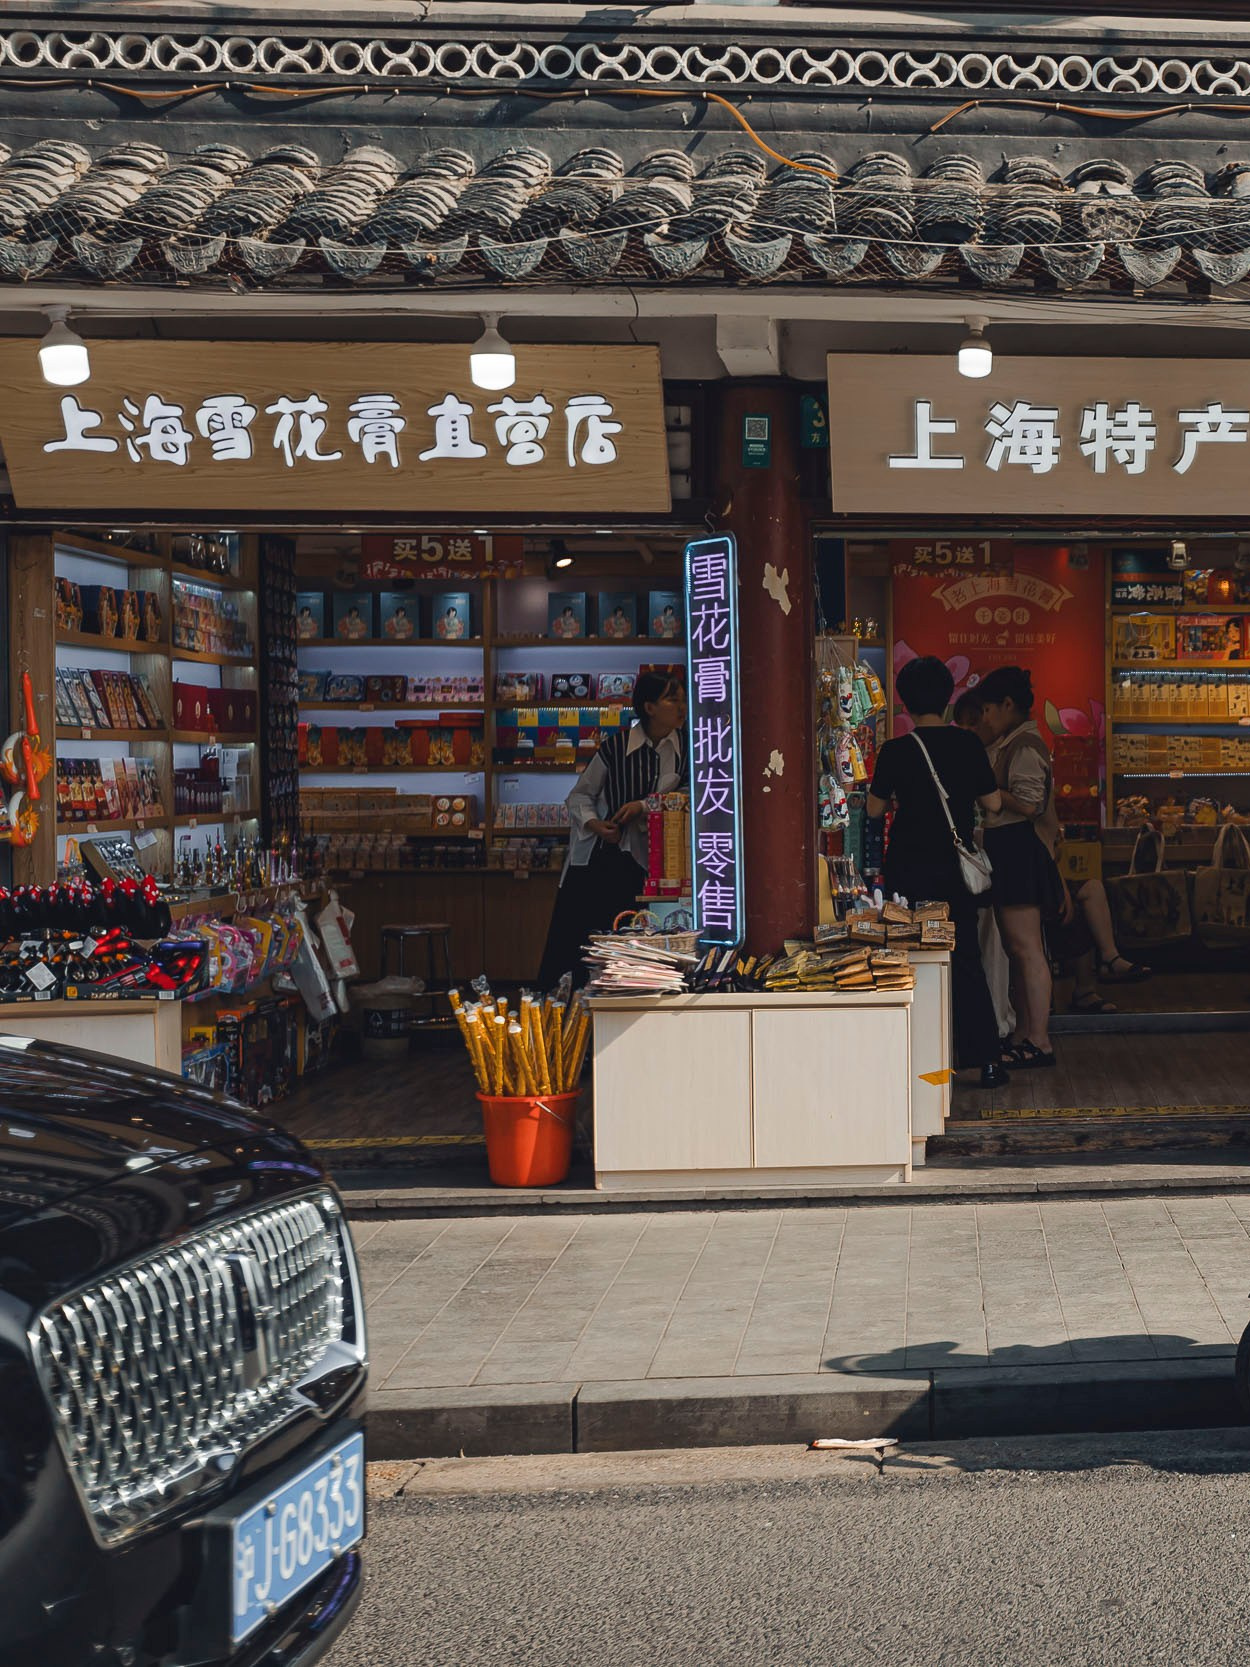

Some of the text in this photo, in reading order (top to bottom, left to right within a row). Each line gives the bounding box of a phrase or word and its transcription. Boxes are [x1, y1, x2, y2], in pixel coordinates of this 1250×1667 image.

[42, 392, 625, 468] 上海雪花膏直营店
[393, 535, 494, 562] 买5送1
[913, 540, 992, 565] 买5送1
